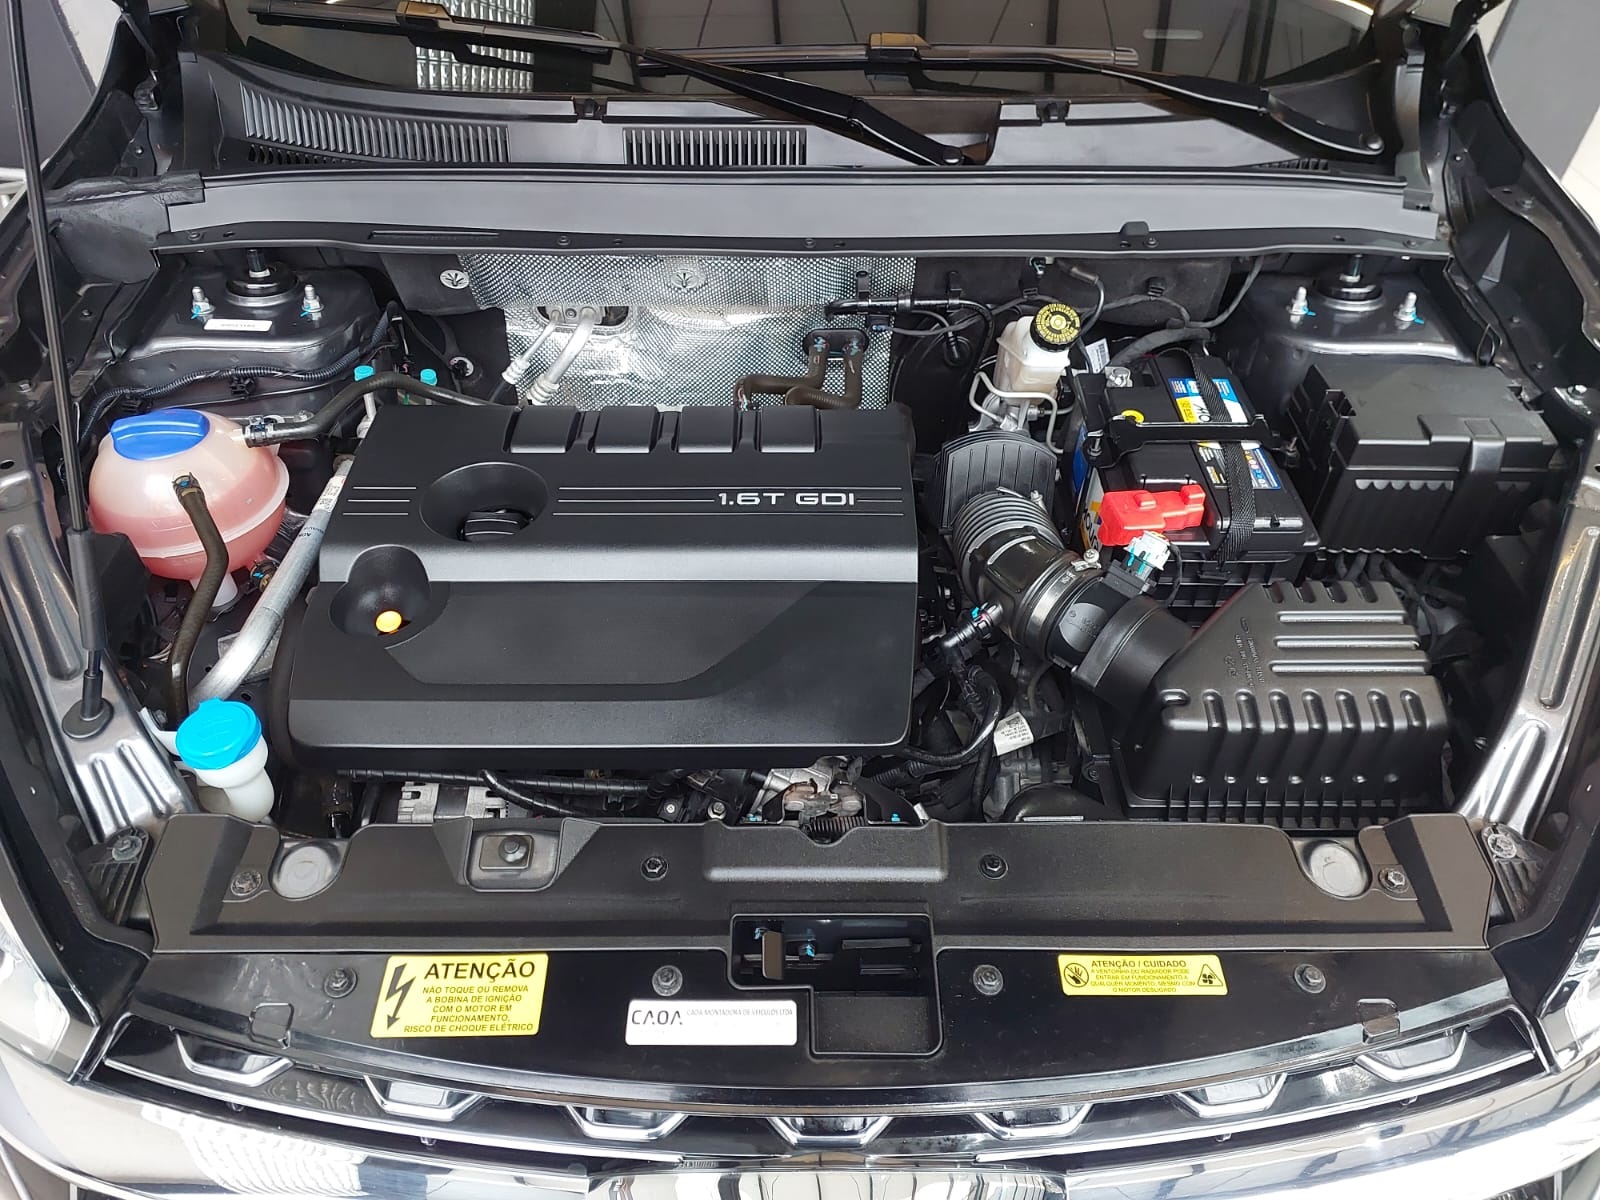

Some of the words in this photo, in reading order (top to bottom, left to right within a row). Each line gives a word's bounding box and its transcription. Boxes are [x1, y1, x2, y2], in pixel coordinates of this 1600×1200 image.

[718, 492, 785, 506] 1.6T
[795, 492, 855, 506] GDI
[1091, 959, 1136, 969] ATENÇÃO
[1143, 960, 1187, 968] CUIDADO
[424, 958, 535, 983] ATENÇÃO
[422, 985, 442, 994] NÃO
[444, 986, 475, 994] TOQUE
[492, 985, 529, 993] REMOVA
[470, 995, 484, 1003] DE
[485, 993, 522, 1003] IGNIÇÃO
[432, 1005, 453, 1013] COM
[455, 1005, 463, 1013] O
[464, 1004, 497, 1012] MOTOR
[499, 1004, 512, 1012] EM
[430, 1014, 510, 1023] FUNCIONAMENTO,
[631, 1009, 683, 1026] CAOA
[403, 1025, 432, 1033] RISCO
[448, 1024, 487, 1032] CHOQUE
[489, 1022, 534, 1031] ELÉTRICO
